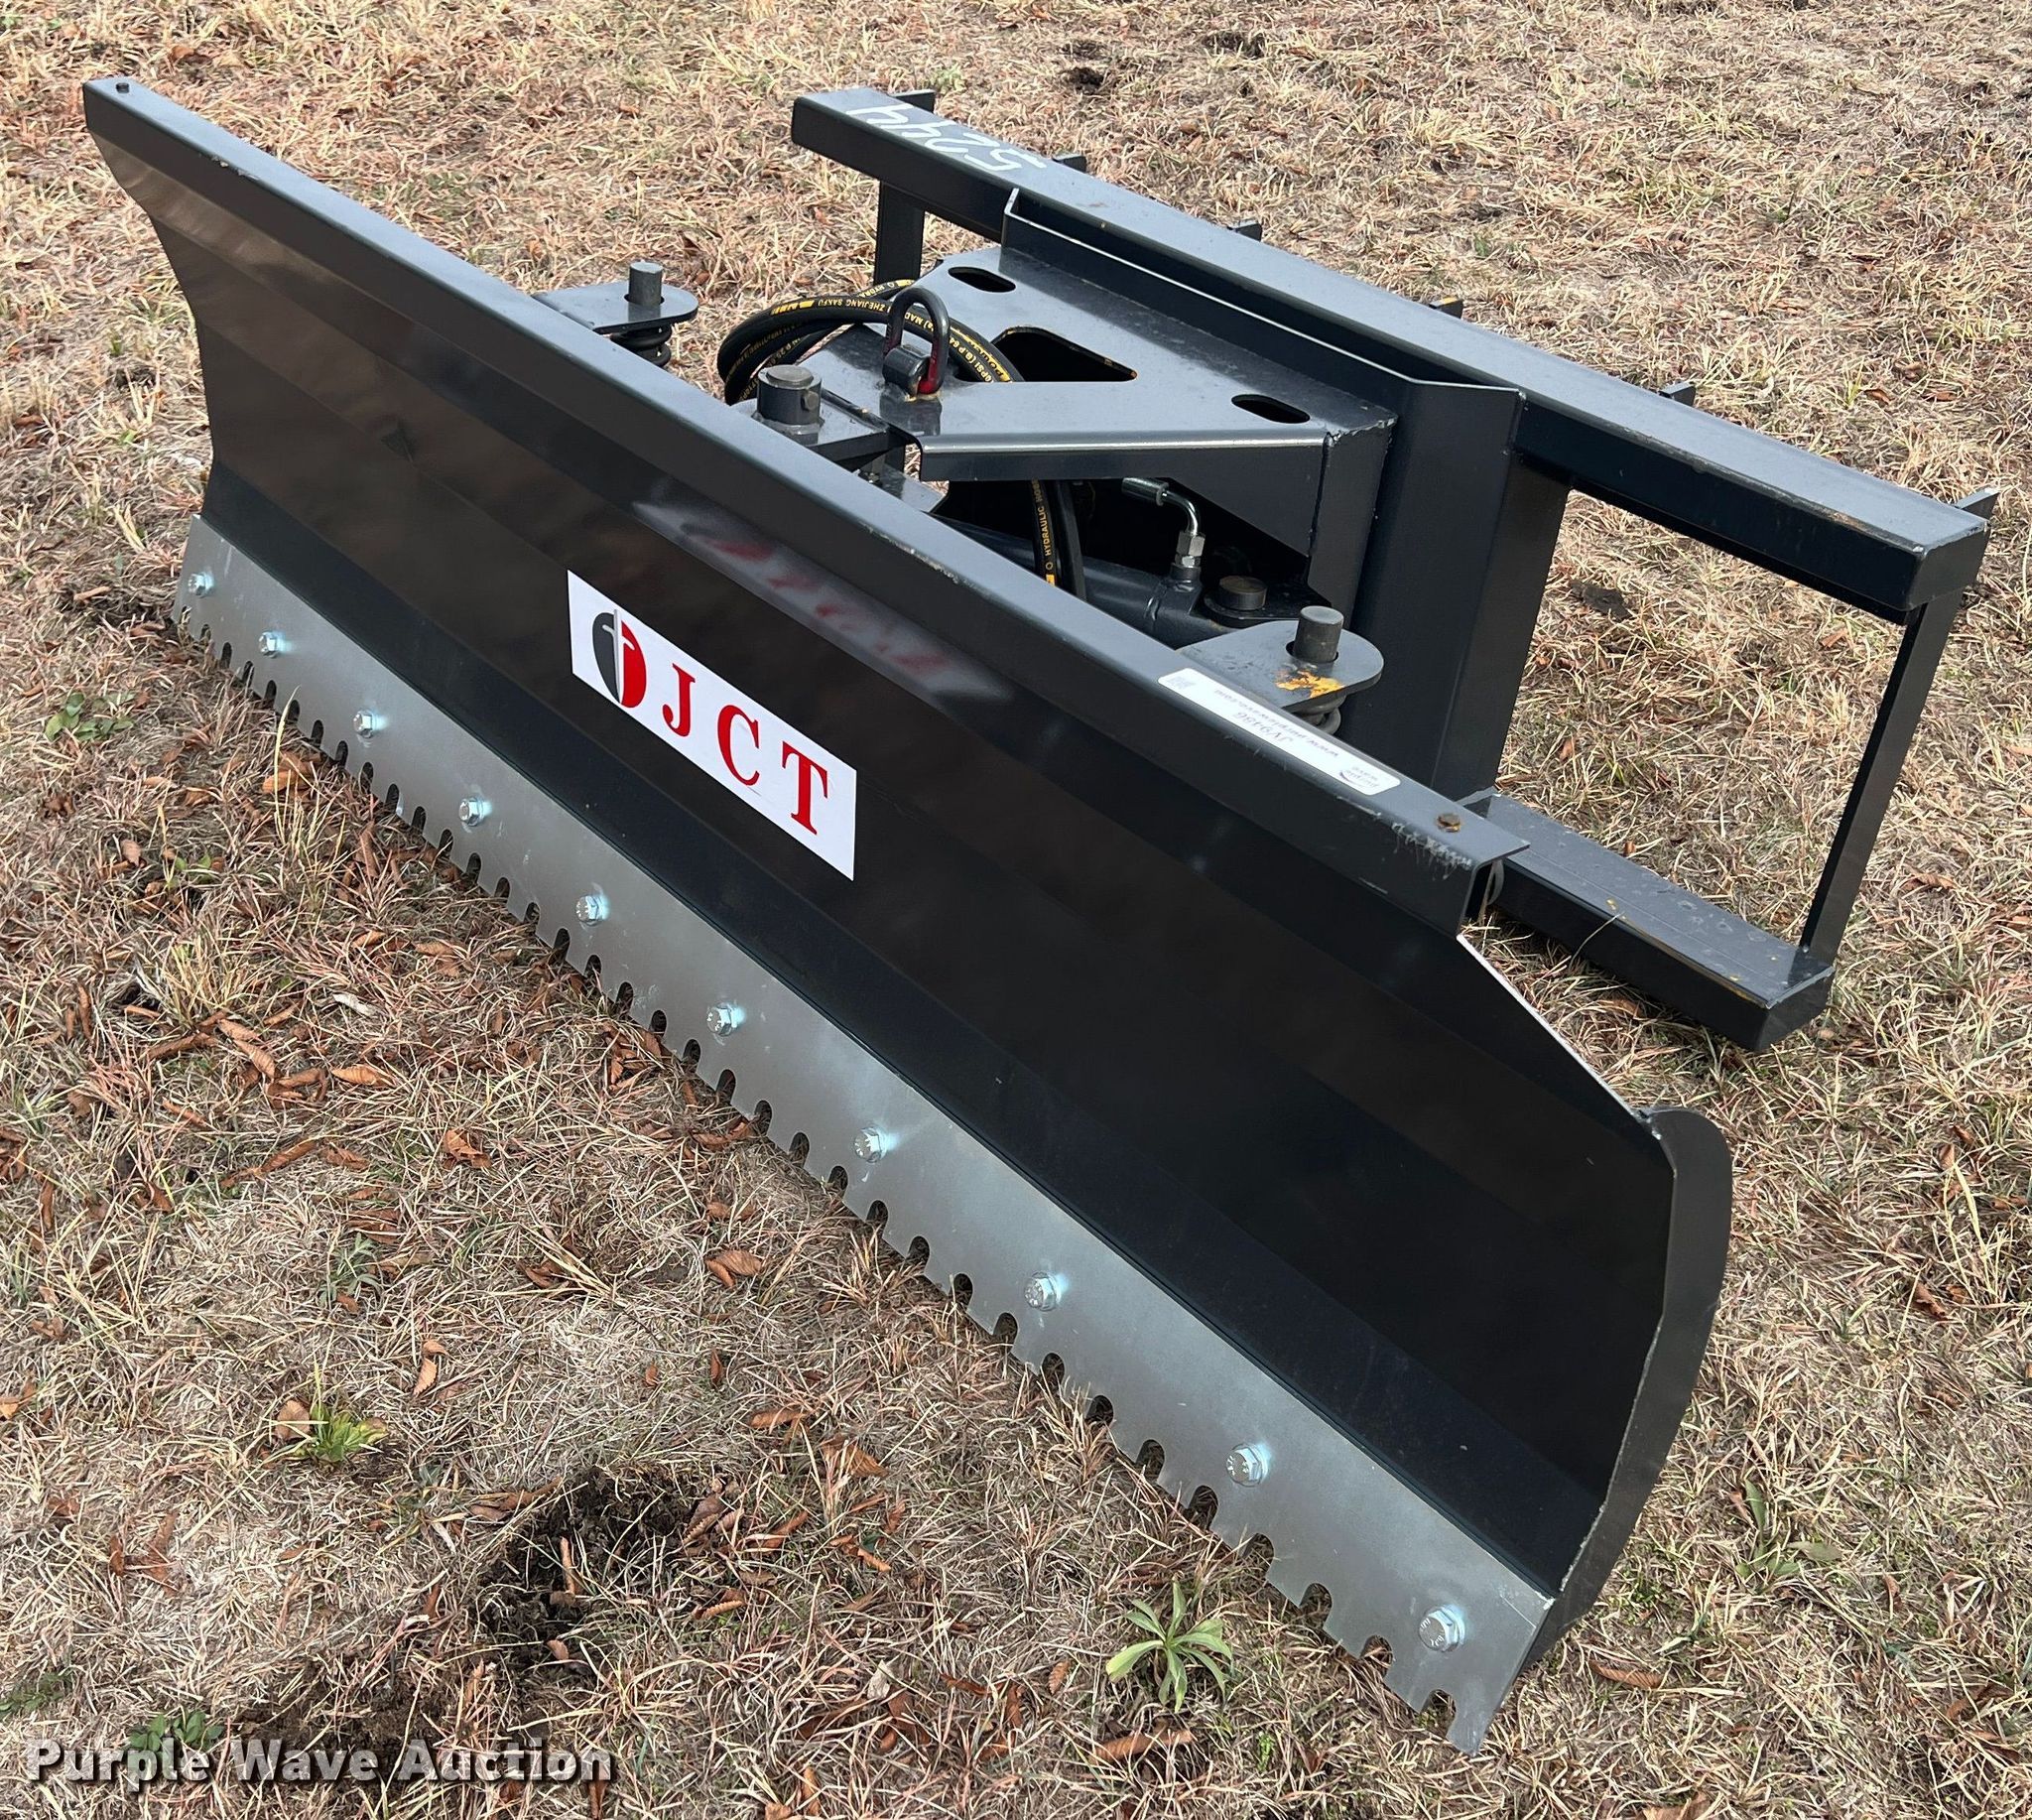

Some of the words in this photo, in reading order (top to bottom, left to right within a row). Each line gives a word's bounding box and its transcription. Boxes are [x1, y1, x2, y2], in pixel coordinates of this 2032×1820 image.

[845, 103, 1048, 172] 5244
[1038, 506, 1053, 556] HYDRAULIC
[662, 662, 828, 836] JCT
